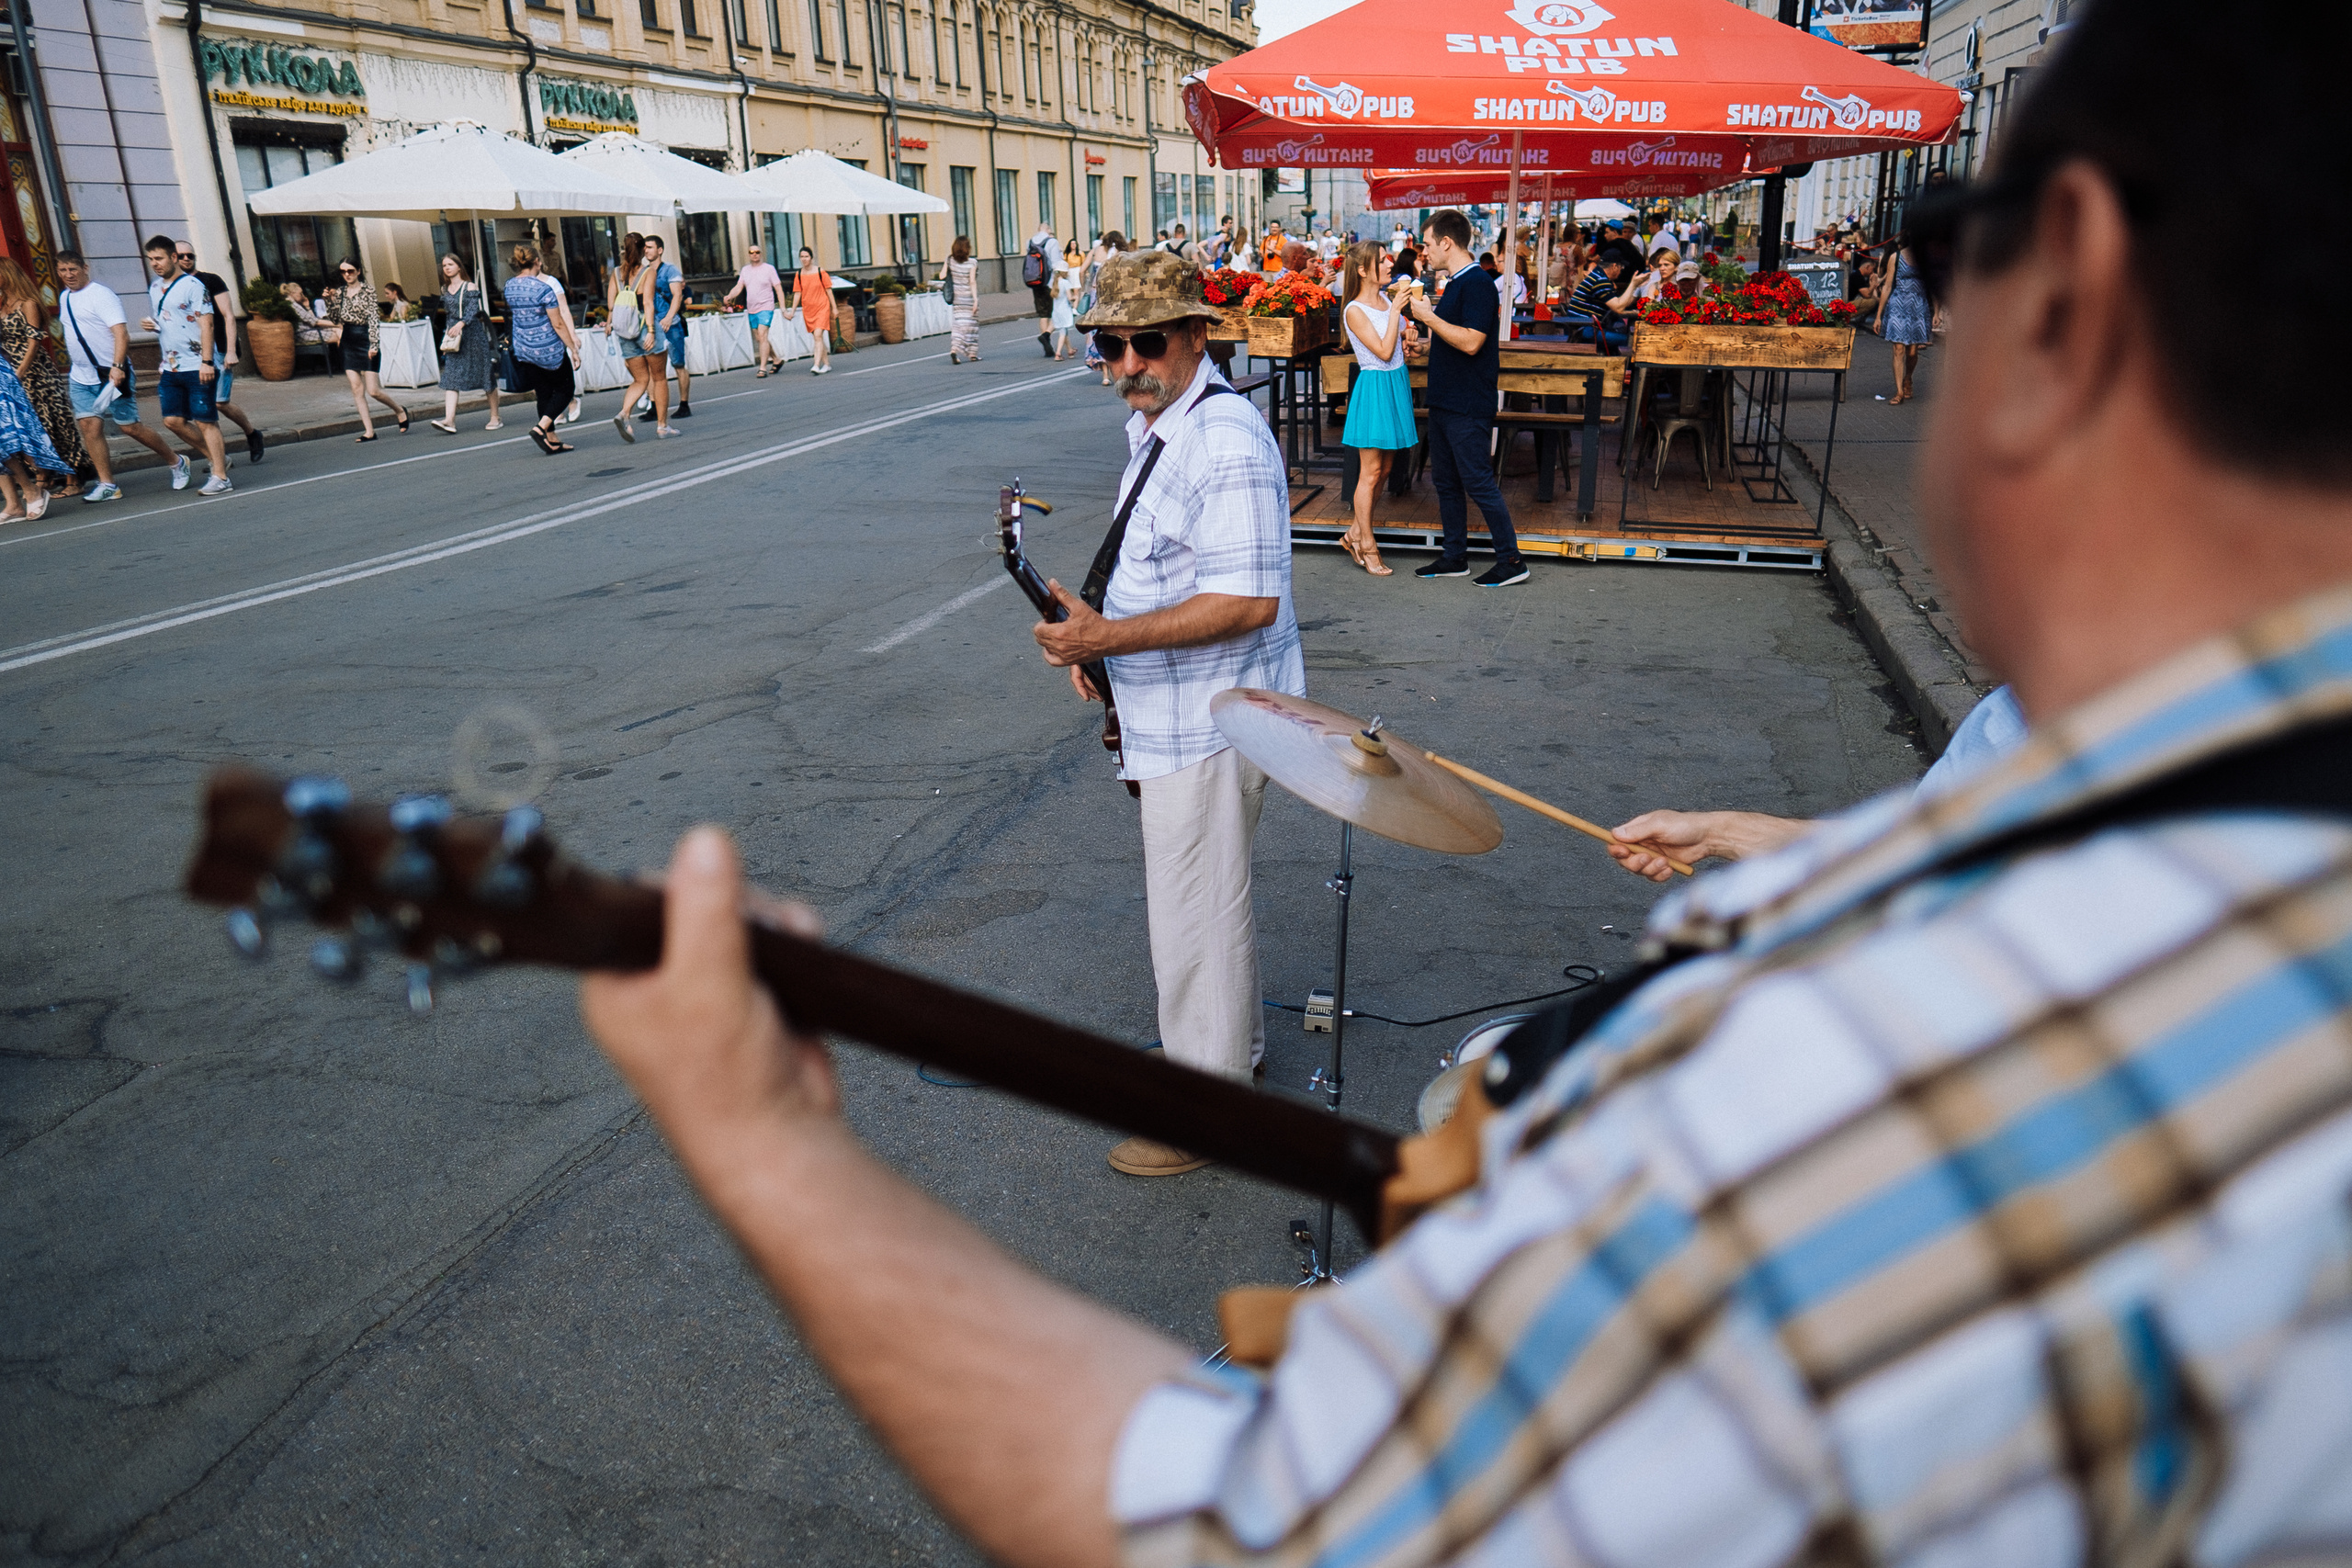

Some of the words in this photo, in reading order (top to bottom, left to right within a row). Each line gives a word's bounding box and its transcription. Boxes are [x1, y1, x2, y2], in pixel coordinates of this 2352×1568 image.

[1446, 33, 1679, 57] SHATUN
[198, 40, 367, 96] РУККОЛА
[1505, 56, 1628, 74] PUB
[218, 91, 277, 107] італійське
[279, 97, 307, 112] кафе
[309, 101, 328, 112] для
[540, 82, 639, 122] РУККОЛА
[1251, 96, 1324, 118] ATUN
[1363, 96, 1415, 118] PUB
[1474, 97, 1576, 121] SHATUN
[1614, 100, 1668, 123] PUB
[1726, 104, 1829, 129] SHATUN
[1868, 109, 1922, 131] PUB
[1821, 272, 1838, 288] 12
